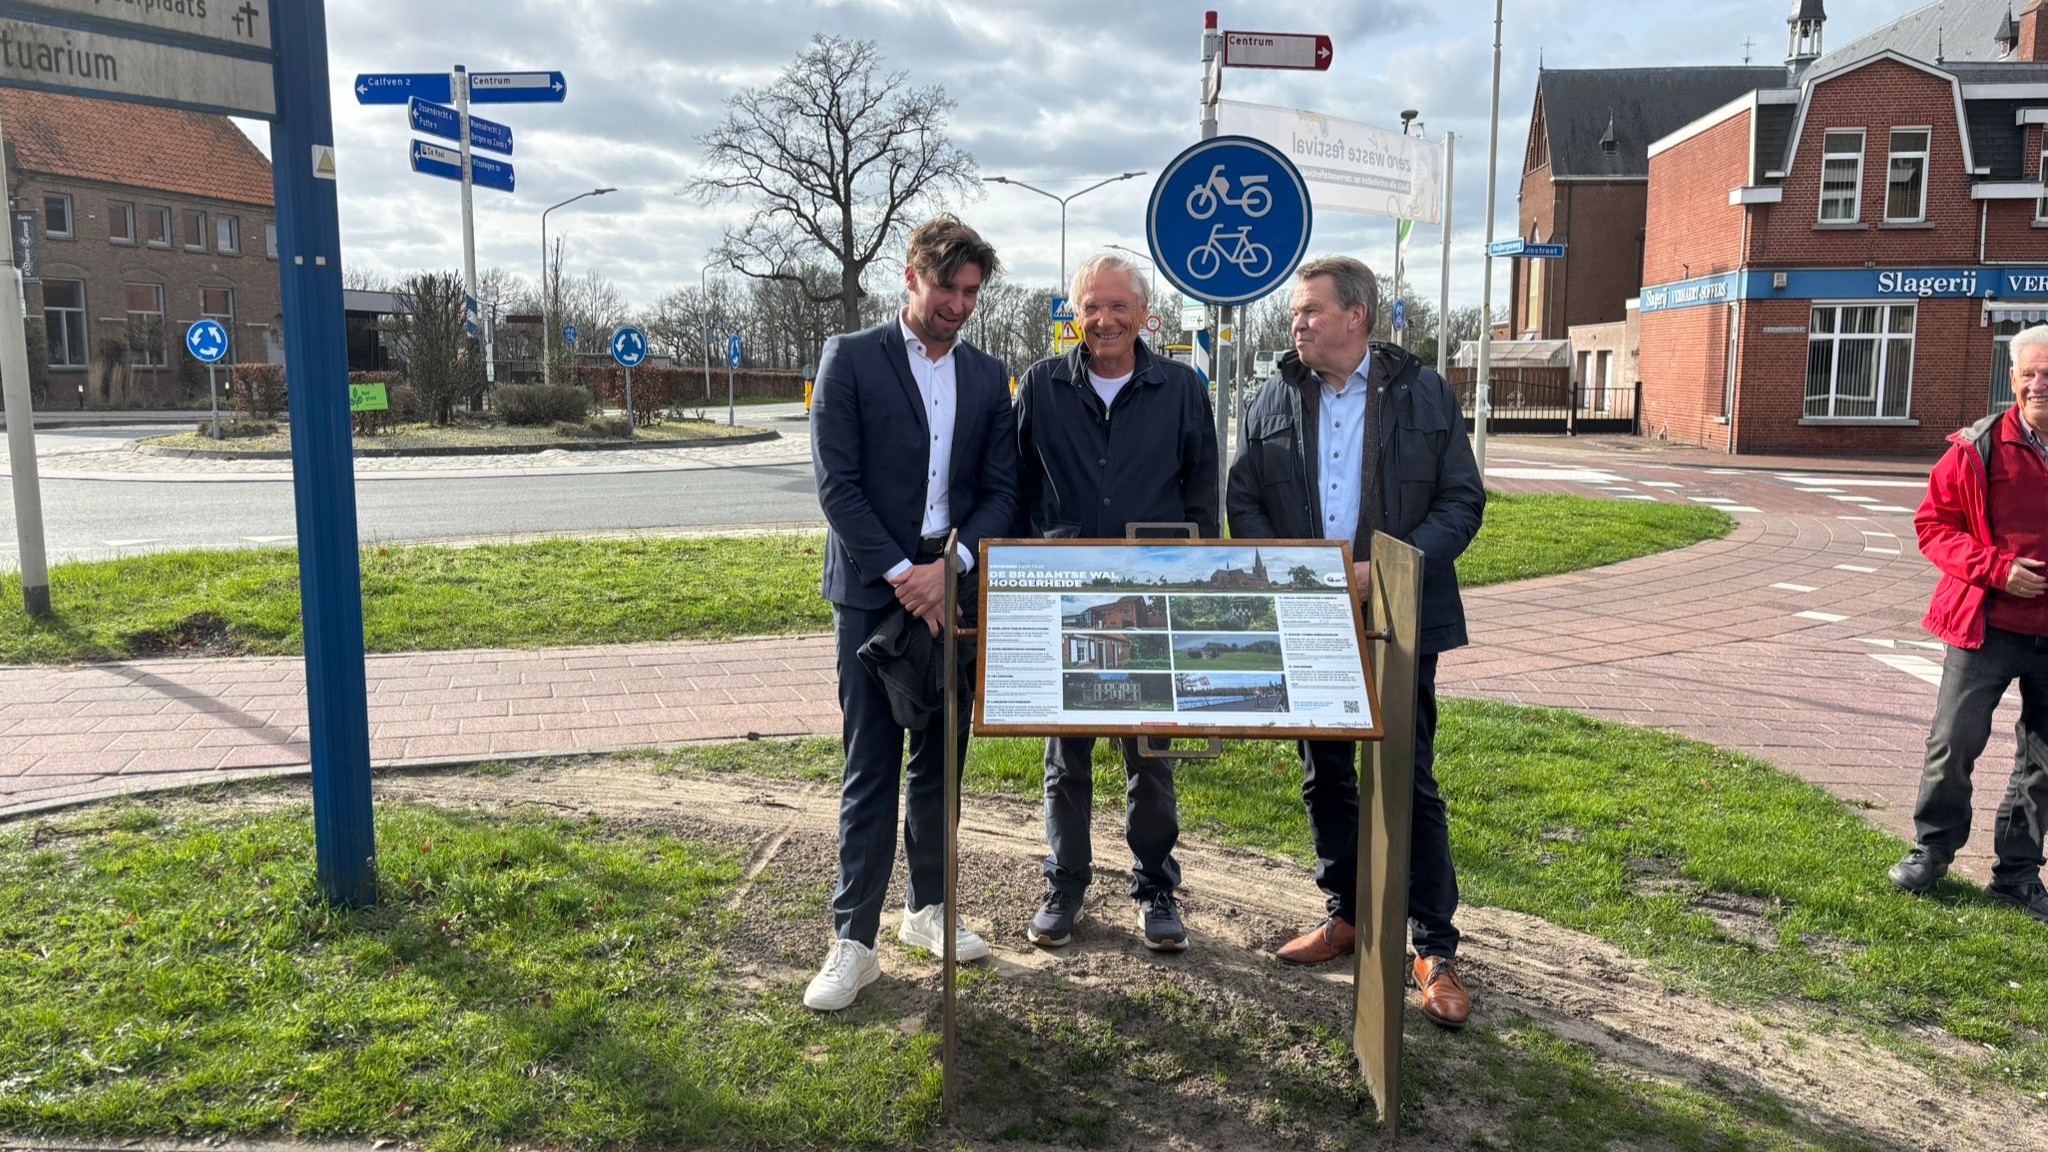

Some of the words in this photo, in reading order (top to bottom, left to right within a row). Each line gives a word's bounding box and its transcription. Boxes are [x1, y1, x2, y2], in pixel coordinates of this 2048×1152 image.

[1229, 36, 1274, 47] Centrum
[0, 30, 117, 82] tuarium
[368, 77, 403, 86] Calfven
[405, 78, 411, 86] 2
[473, 77, 511, 85] Centrum
[418, 103, 448, 119] Ossendrecht
[419, 117, 433, 128] Putte
[471, 132, 486, 144] Bergen
[493, 138, 504, 147] Zoom
[473, 159, 495, 171] Vlissingen
[1524, 247, 1558, 255] uisstraat
[1878, 271, 1977, 297] Slagerij
[2008, 276, 2048, 292] VER
[1009, 571, 1087, 579] BRABANTSE
[1090, 571, 1118, 579] WAL
[989, 580, 1082, 588] HOOGERHEIDE
